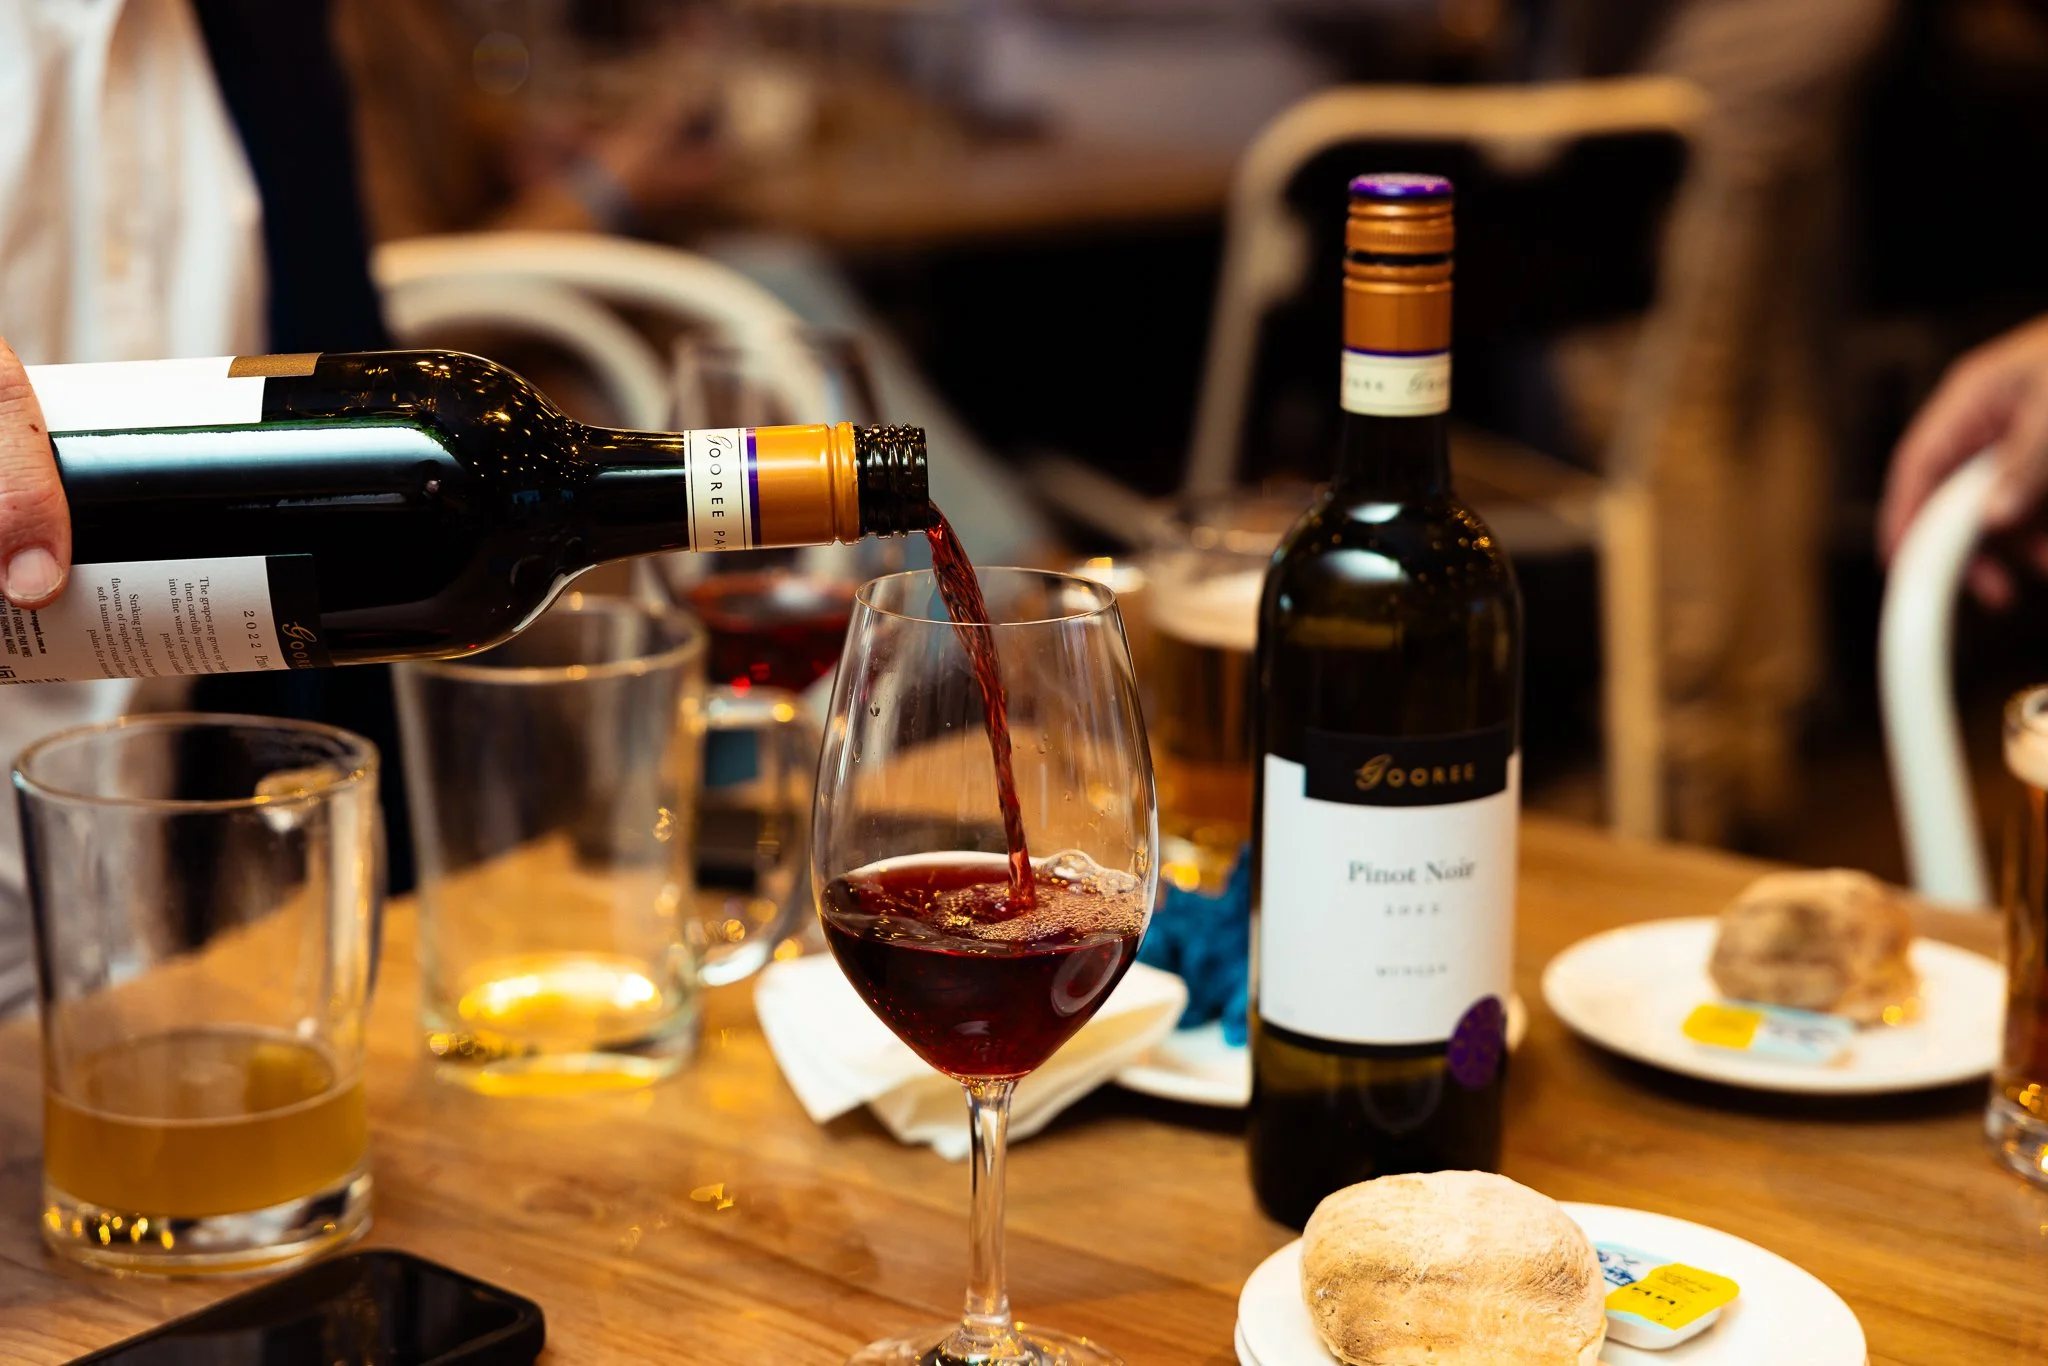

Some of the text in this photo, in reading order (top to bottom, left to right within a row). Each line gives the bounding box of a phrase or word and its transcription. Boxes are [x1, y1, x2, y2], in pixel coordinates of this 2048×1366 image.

[97, 586, 108, 602] soft
[168, 578, 178, 596] into
[184, 582, 194, 602] then
[199, 576, 209, 595] The
[111, 578, 123, 612] flavours
[117, 613, 128, 622] of
[129, 593, 143, 626] Striking
[171, 598, 181, 614] fine
[200, 597, 212, 622] grapes
[100, 603, 113, 632] tannins
[174, 615, 186, 637] wines
[188, 603, 202, 635] carefully
[86, 629, 102, 649] palate
[132, 626, 149, 648] purple
[206, 623, 215, 635] are
[243, 610, 262, 649] 2022
[106, 633, 118, 646] and
[160, 632, 175, 650] pride
[179, 636, 190, 644] of
[1349, 858, 1475, 884] Pinot Noir
